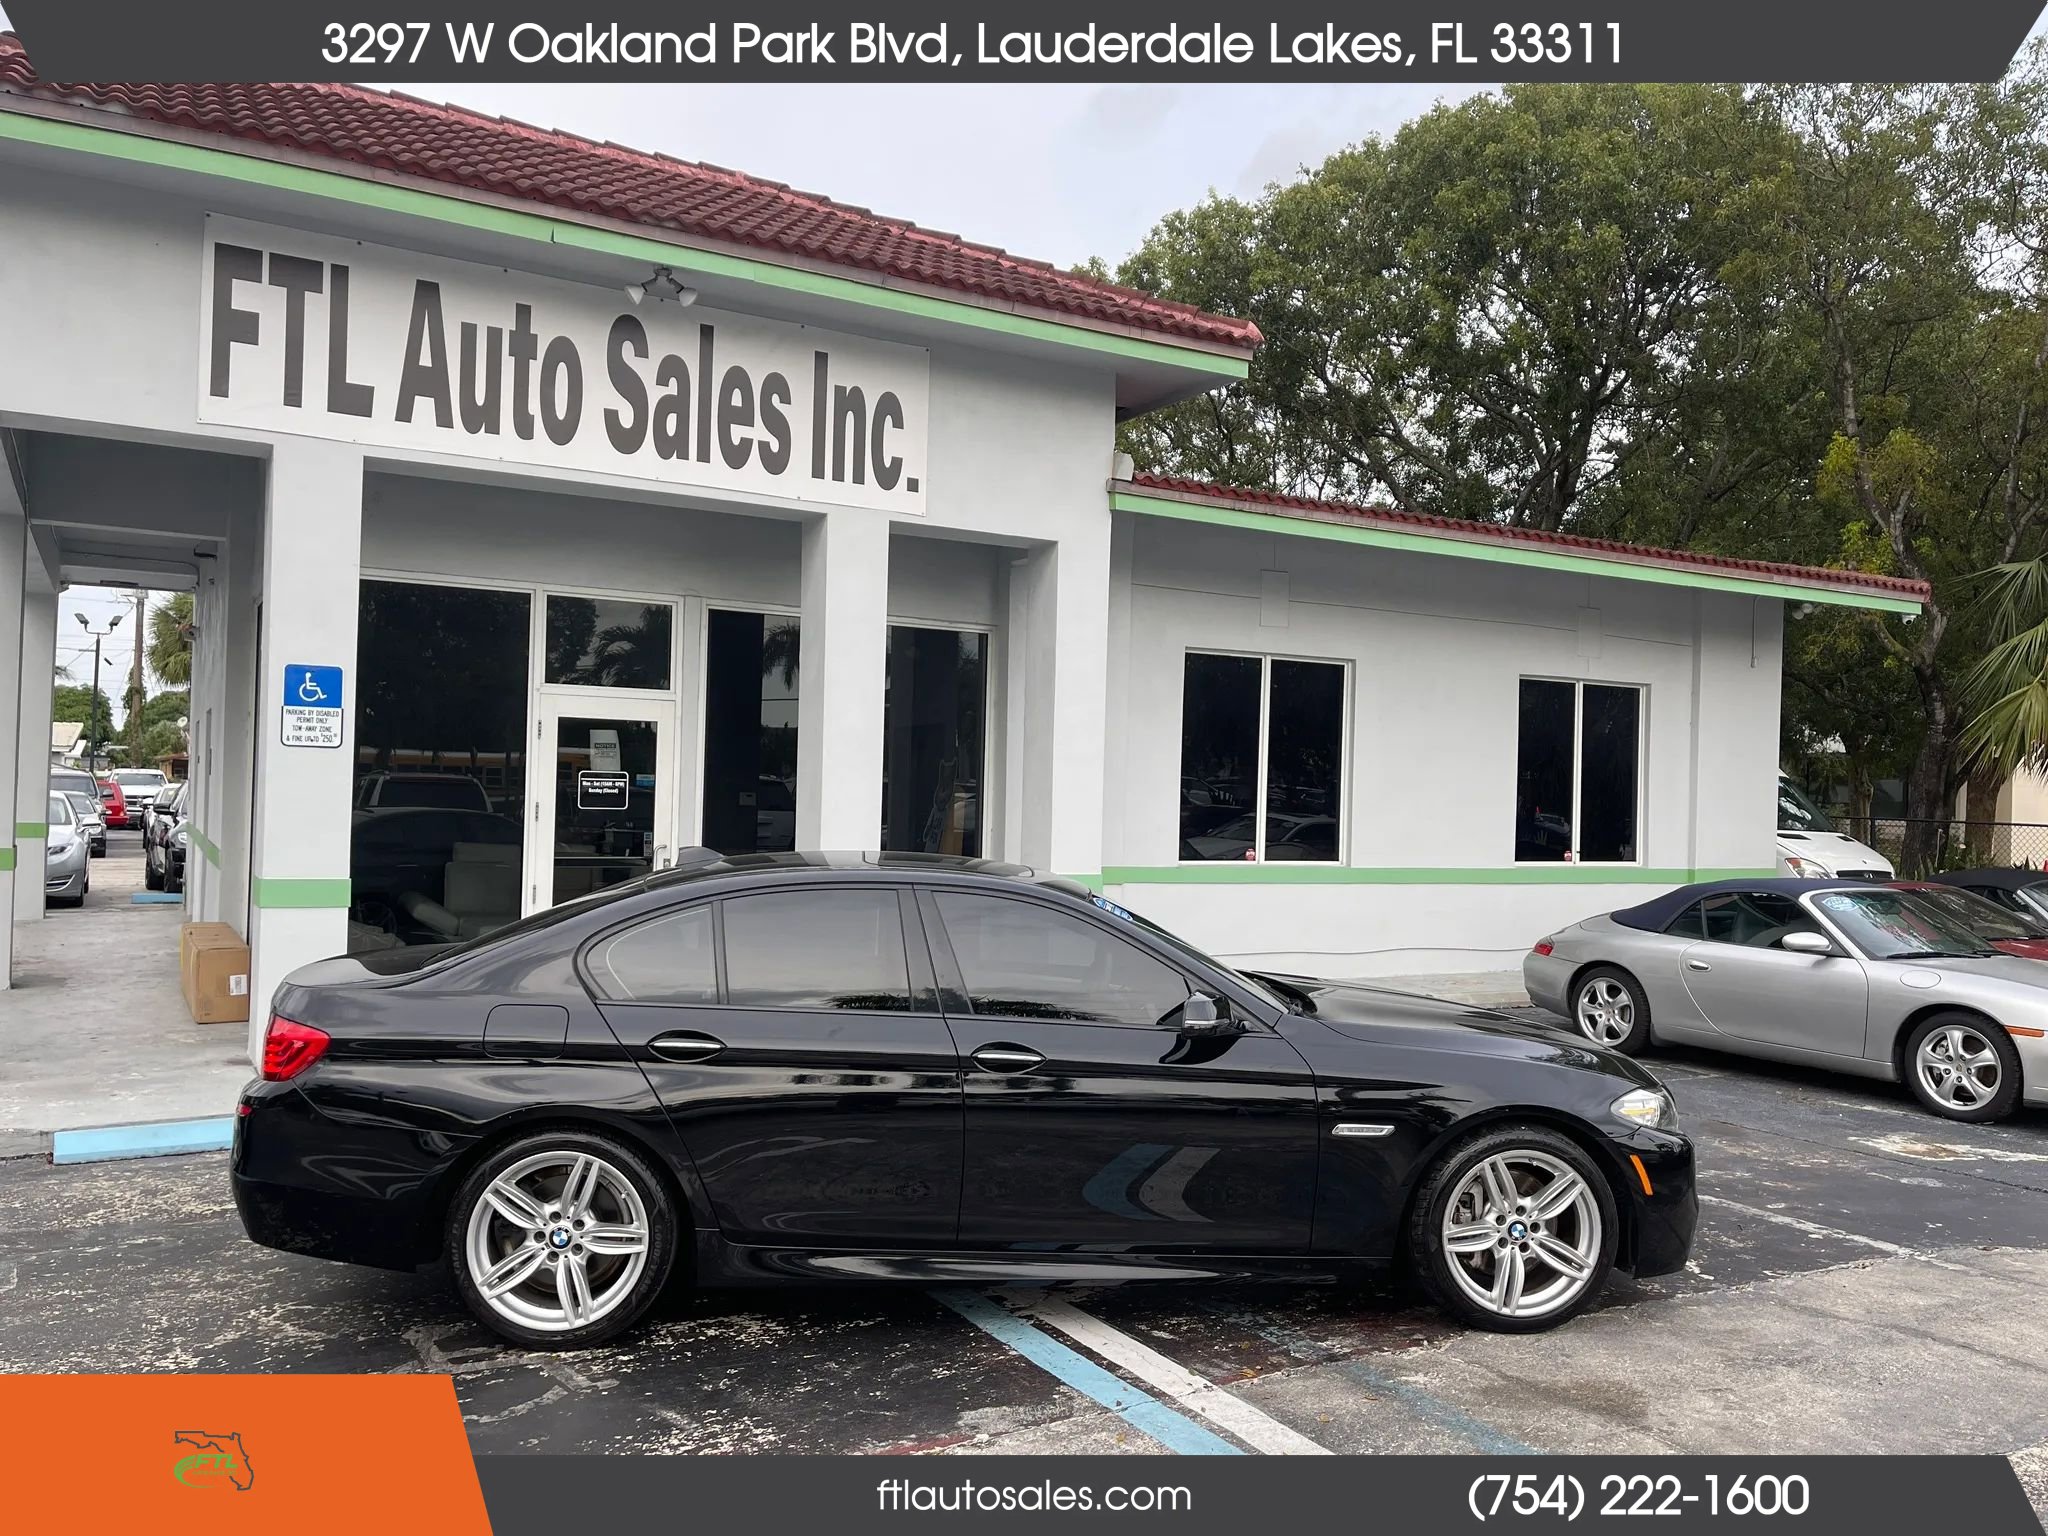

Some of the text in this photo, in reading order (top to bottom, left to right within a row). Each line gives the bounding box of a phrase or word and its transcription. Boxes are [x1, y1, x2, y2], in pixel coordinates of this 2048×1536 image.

[209, 241, 920, 493] FTL Auto Sales Inc.
